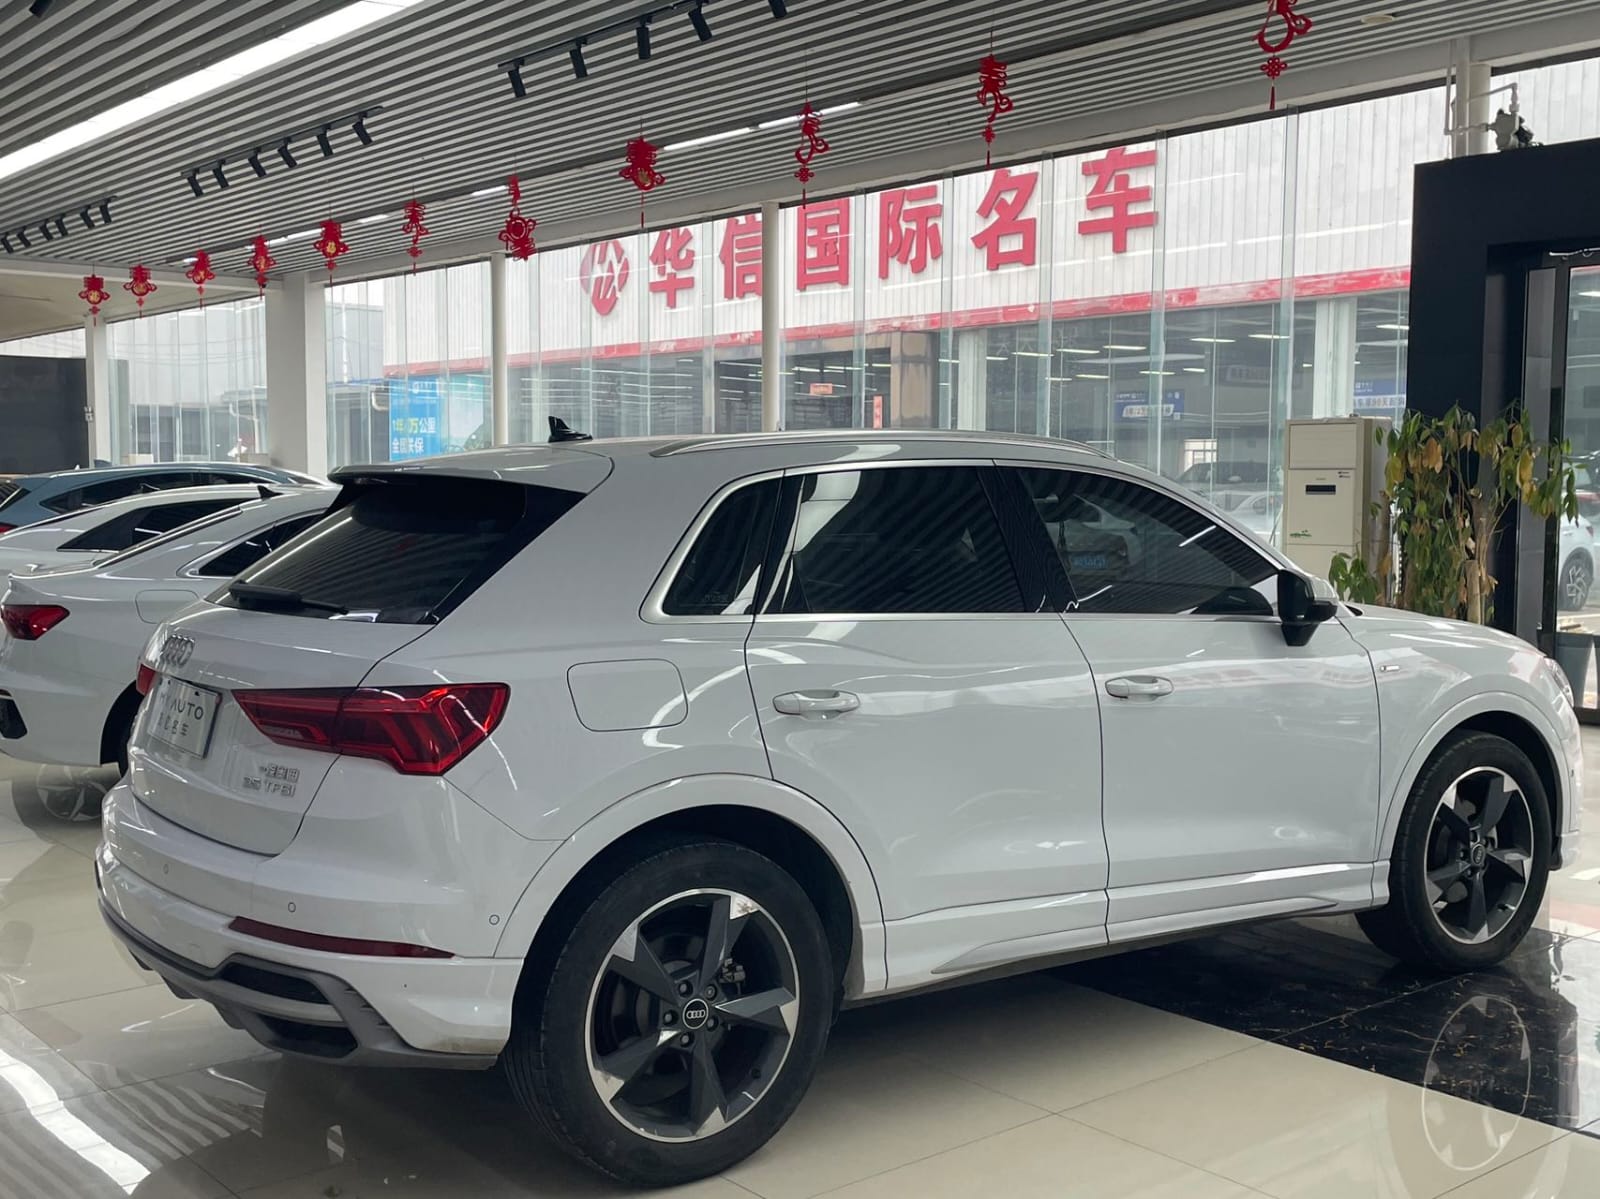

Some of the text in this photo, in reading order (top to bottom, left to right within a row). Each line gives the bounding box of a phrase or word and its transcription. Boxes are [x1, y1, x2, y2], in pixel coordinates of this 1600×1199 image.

[649, 148, 1158, 309] 华信国际名车
[170, 699, 204, 720] AUTO
